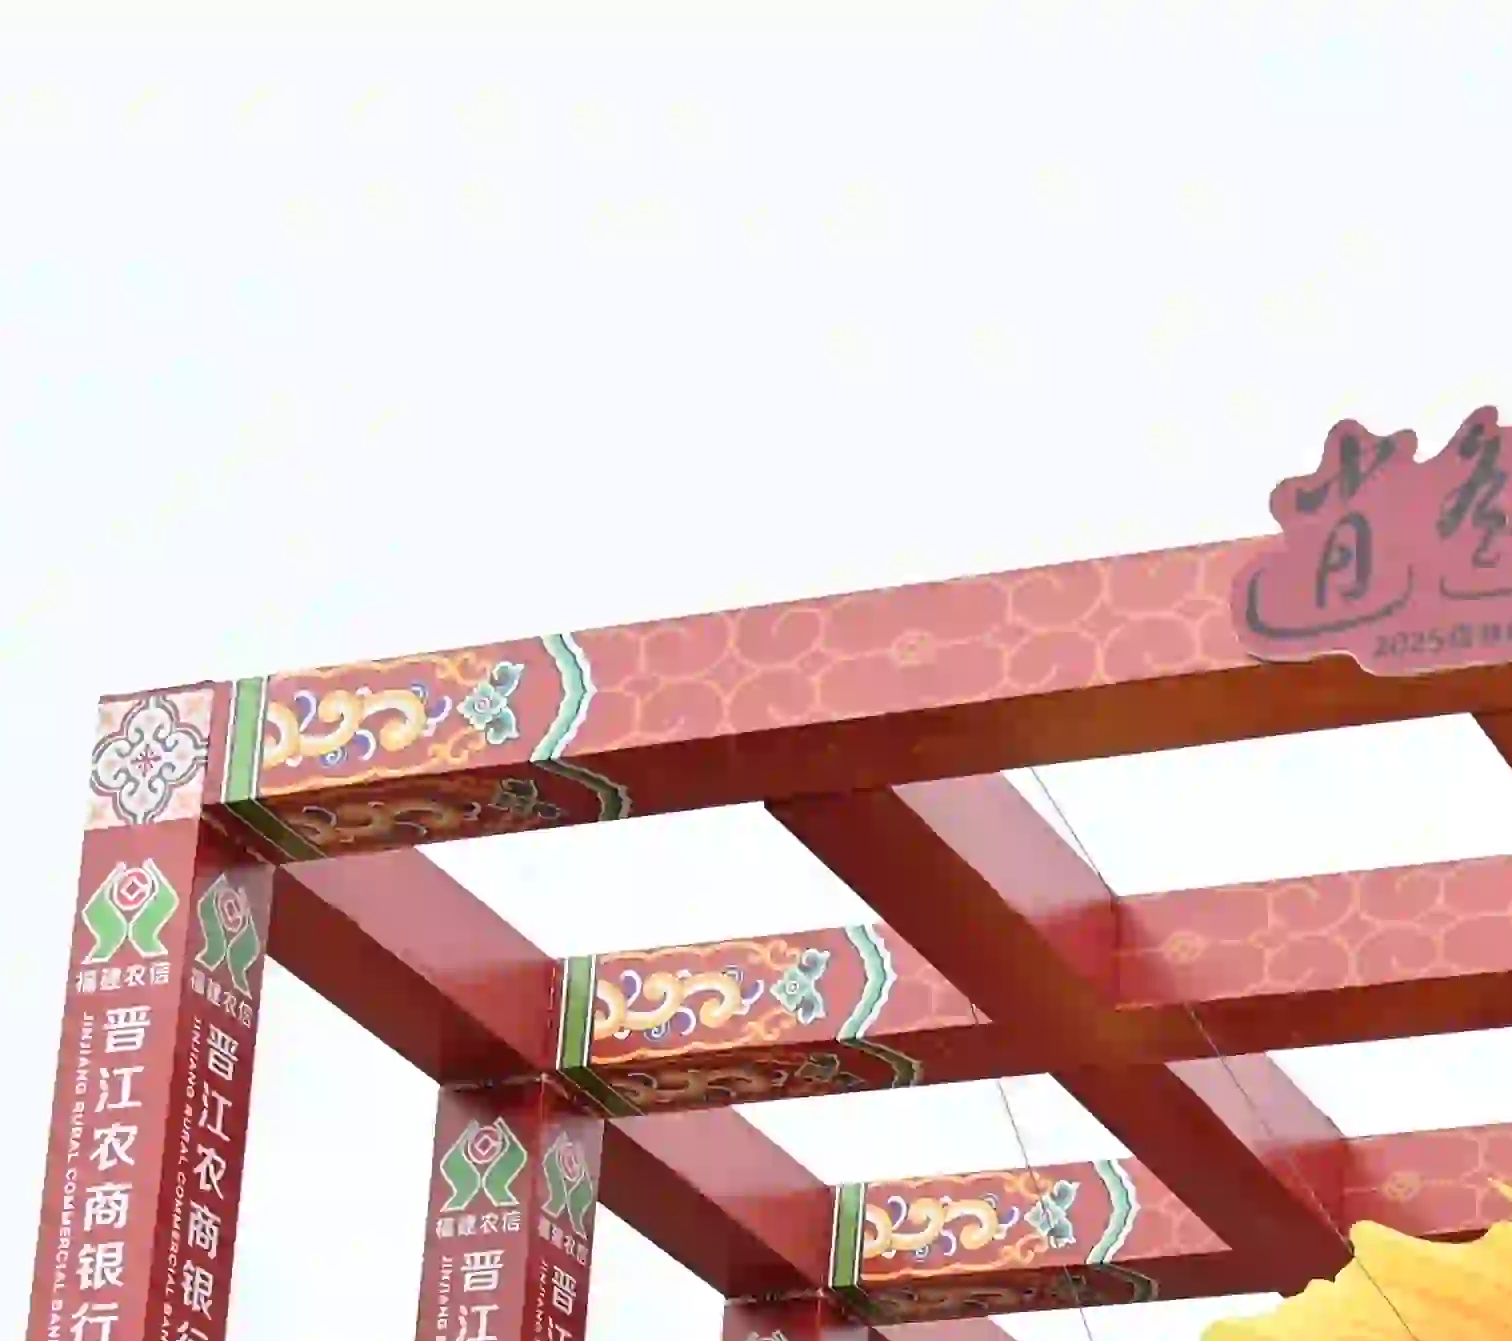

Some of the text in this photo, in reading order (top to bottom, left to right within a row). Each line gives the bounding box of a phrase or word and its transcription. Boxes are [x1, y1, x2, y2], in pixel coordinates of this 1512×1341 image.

[75, 961, 171, 994] 福建农信
[75, 1011, 95, 1094] JINJIANG
[186, 1017, 202, 1098] JINJIANG
[67, 1101, 85, 1162] RURAL
[178, 1104, 193, 1164] RURAL
[53, 1167, 78, 1291] COMMERCIAL
[165, 1172, 186, 1294] COMMERCIAL
[435, 1210, 521, 1239] 福建农信
